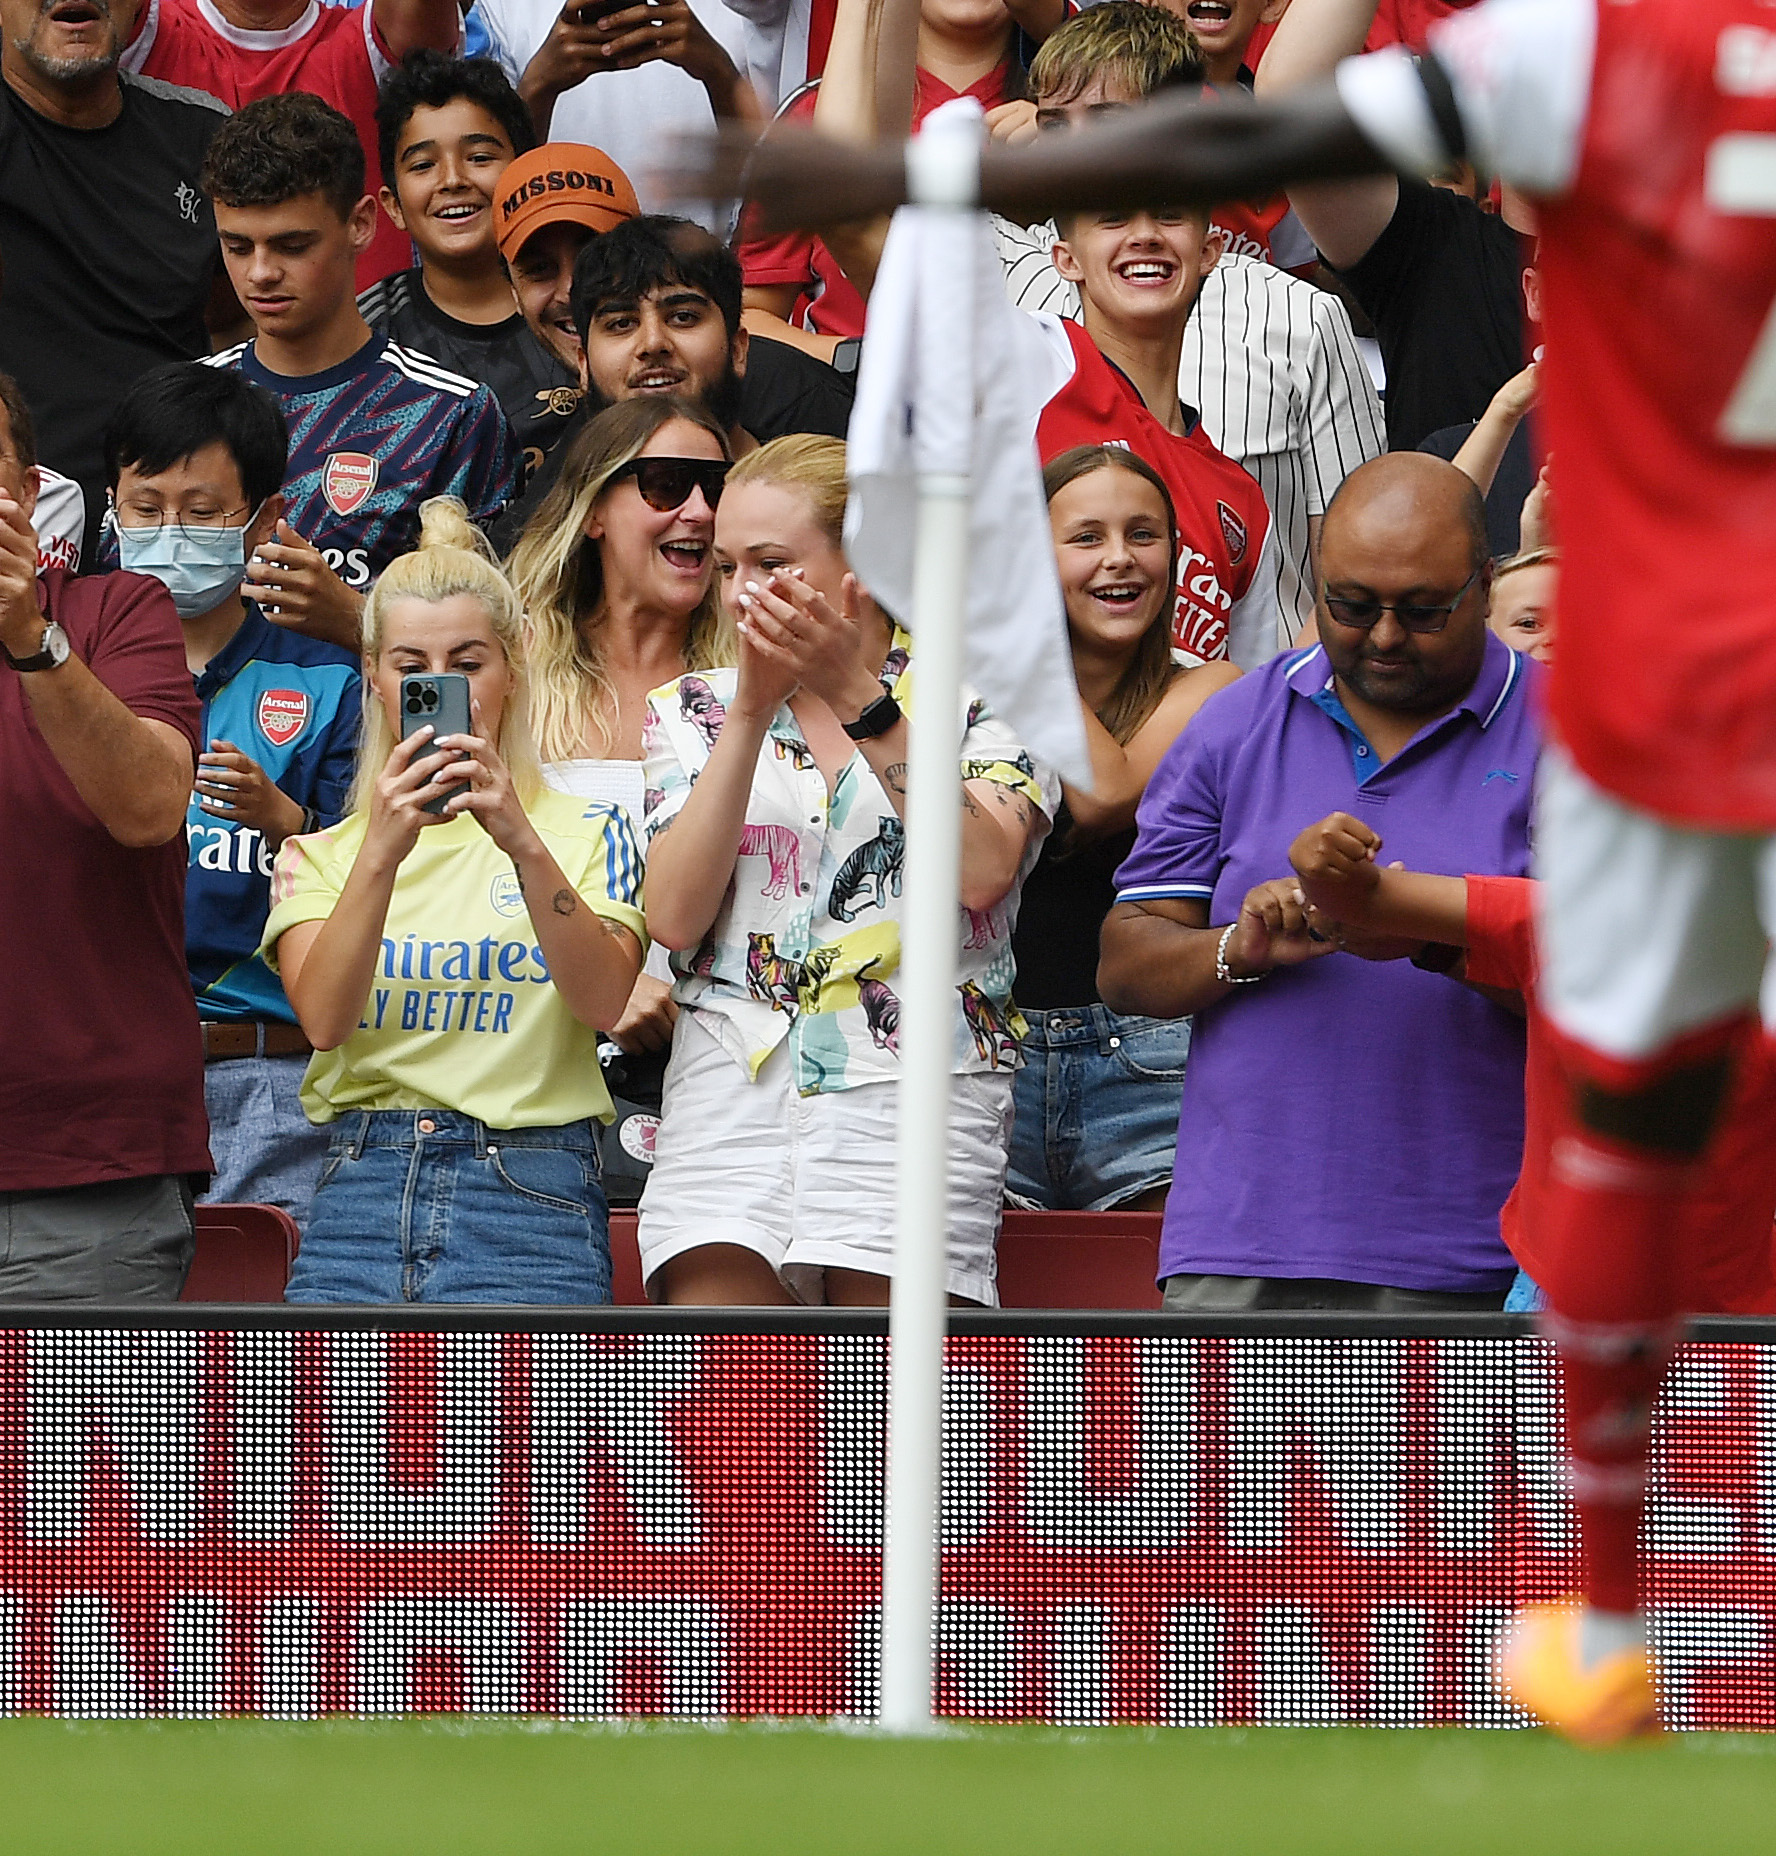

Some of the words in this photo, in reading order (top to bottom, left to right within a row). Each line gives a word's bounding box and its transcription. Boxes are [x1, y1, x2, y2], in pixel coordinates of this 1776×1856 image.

[500, 171, 615, 222] MISSONI
[331, 461, 372, 477] Arsenal
[263, 694, 304, 710] Arsenal
[401, 988, 515, 1034] BETTER
